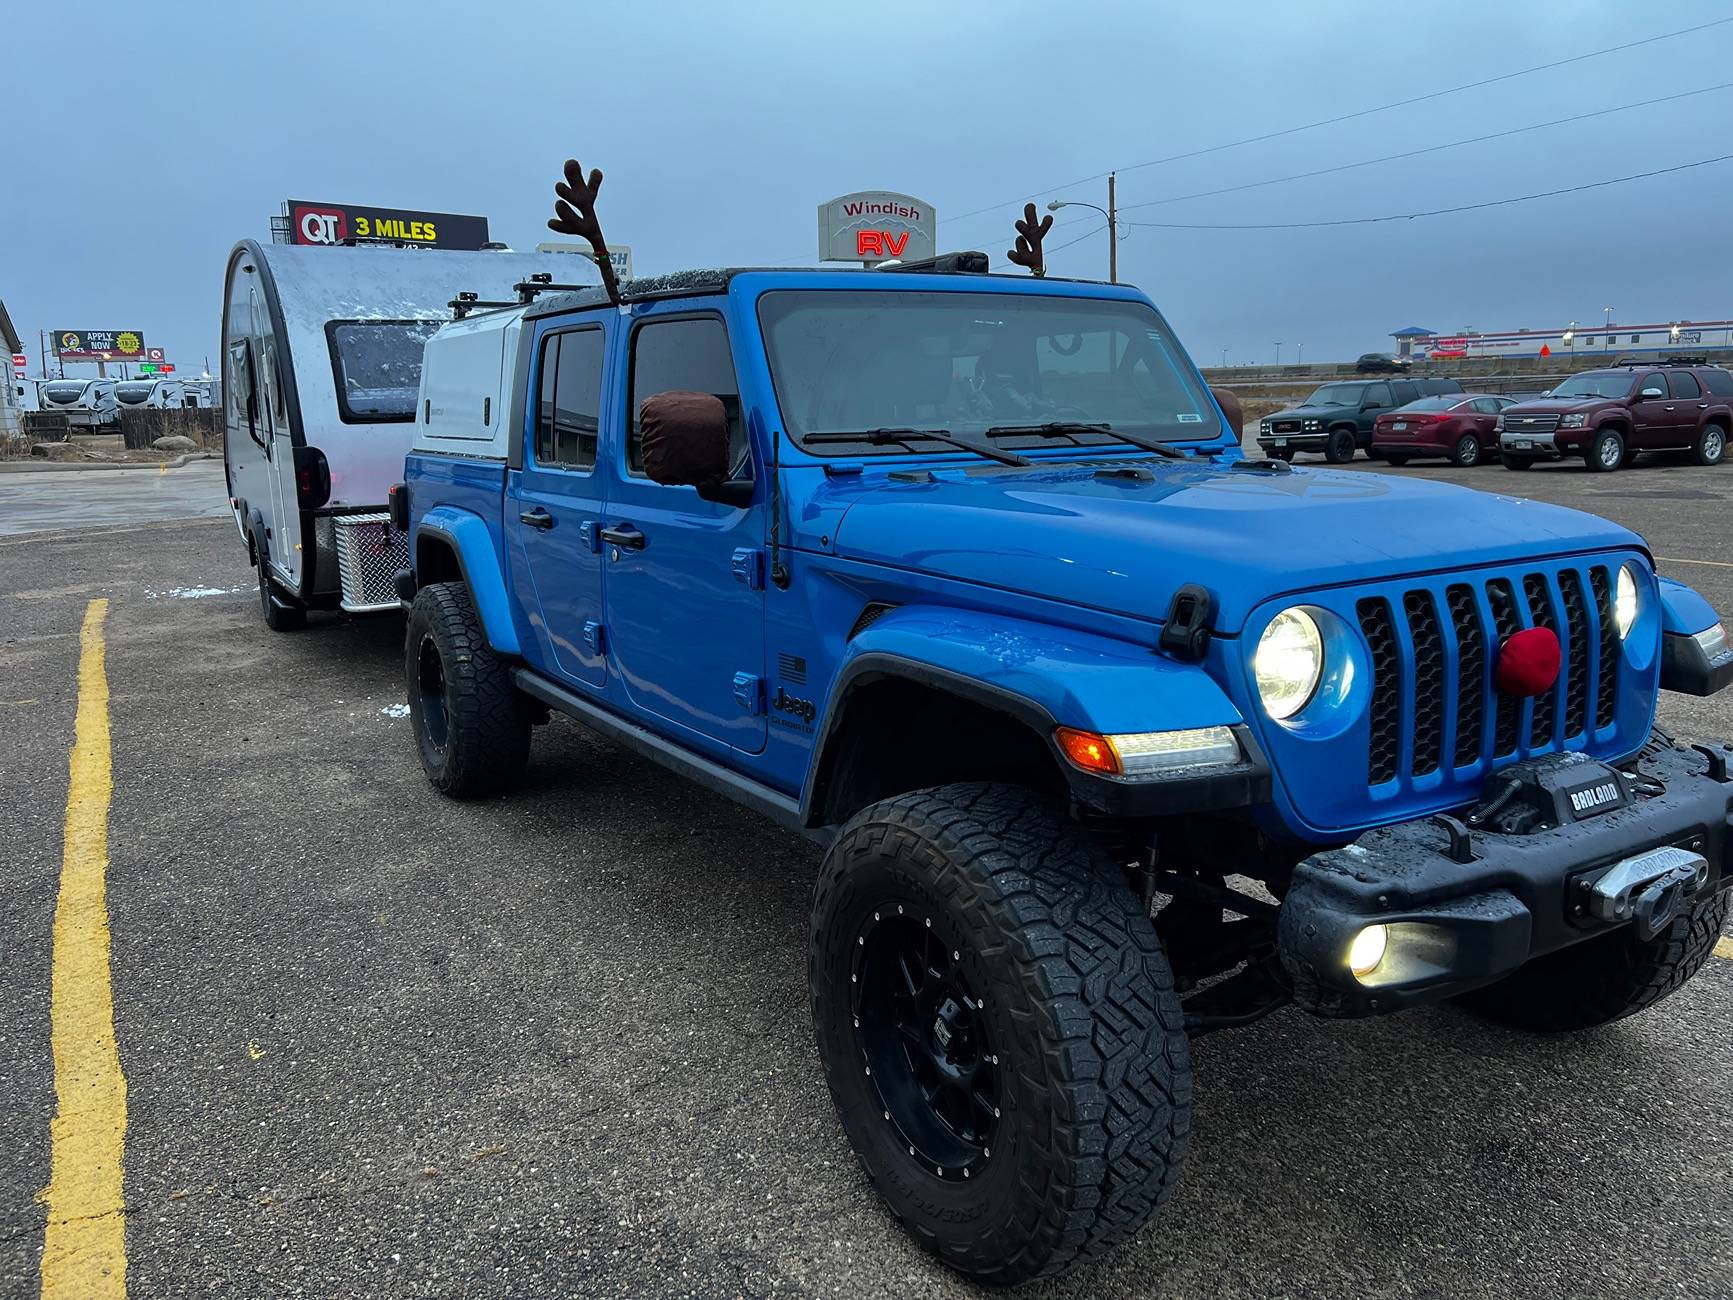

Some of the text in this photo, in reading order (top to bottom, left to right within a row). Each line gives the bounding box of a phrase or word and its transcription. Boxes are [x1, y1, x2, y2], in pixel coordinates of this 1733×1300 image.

[843, 201, 920, 220] Windish
[301, 213, 338, 244] QT
[355, 217, 437, 240] 3 MILES
[857, 230, 910, 257] RV
[87, 332, 112, 341] APPLY
[91, 341, 111, 350] NOW
[772, 686, 816, 724] Jeep
[1570, 783, 1618, 811] BADLAND
